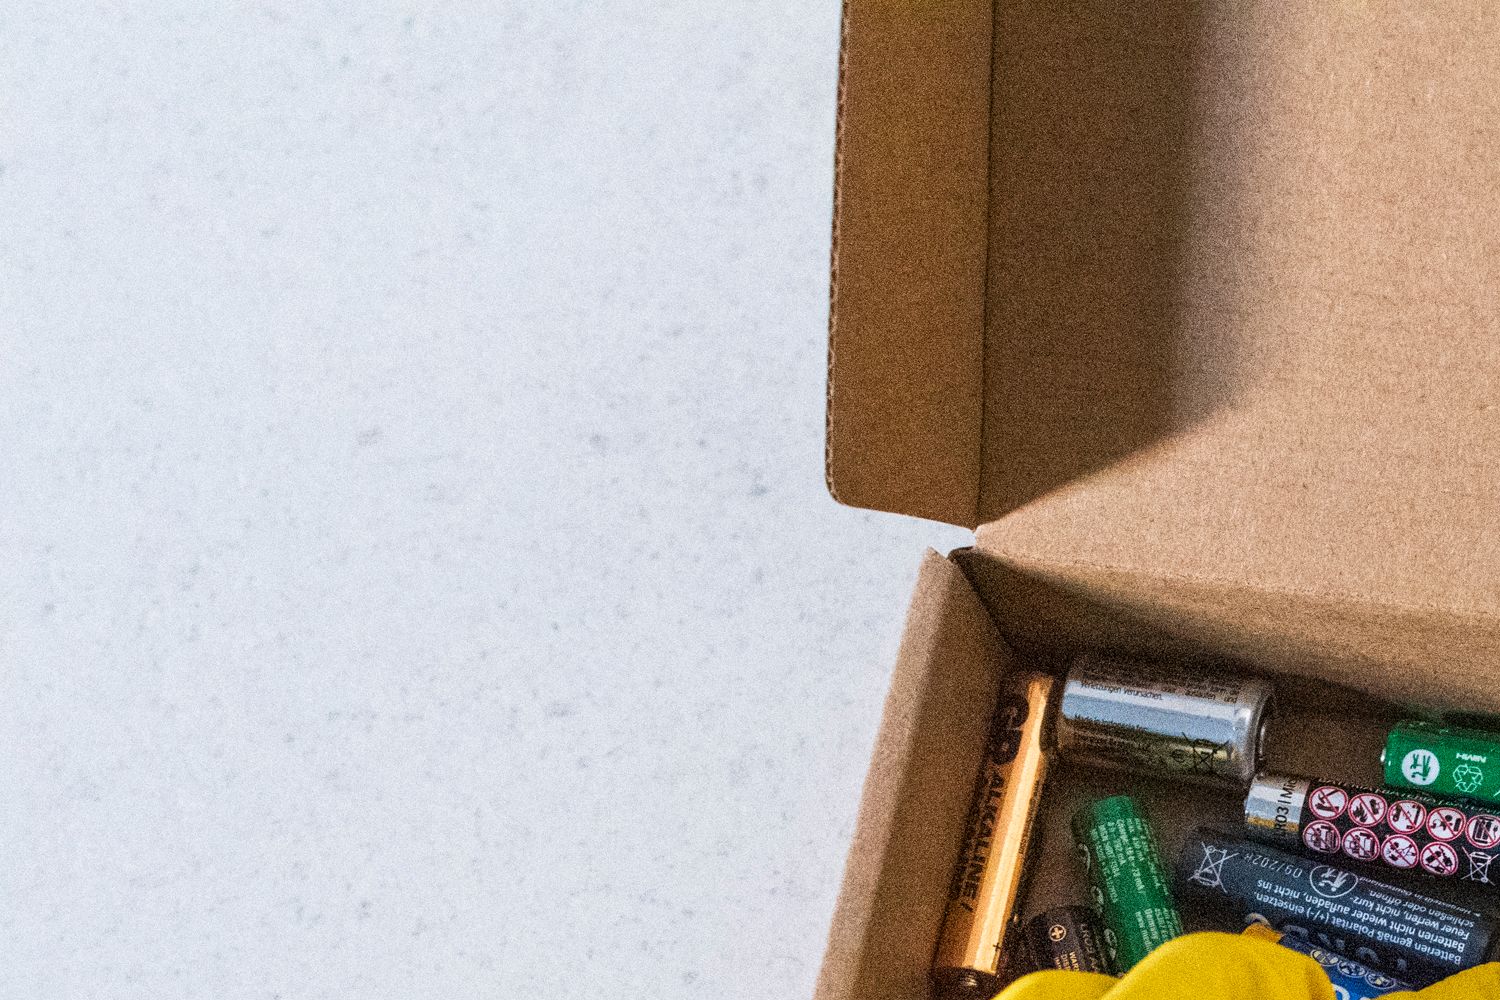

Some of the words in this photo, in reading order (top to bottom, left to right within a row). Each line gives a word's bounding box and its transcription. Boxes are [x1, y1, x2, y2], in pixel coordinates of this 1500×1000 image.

[961, 773, 1006, 900] ALKALINE
[1255, 877, 1273, 892] ins
[1272, 883, 1301, 901] nicht
[1251, 890, 1306, 915] einsetzen.
[1300, 890, 1352, 917] aufladen,
[1347, 893, 1375, 910] kurz-
[1374, 901, 1401, 918] nicht
[1401, 899, 1427, 914] oder
[1329, 915, 1375, 938] Polarität
[1350, 907, 1389, 929] wieder
[1387, 919, 1416, 937] nicht
[1400, 908, 1441, 930] werfen,
[1425, 906, 1475, 930] schließen
[1375, 928, 1413, 949] gemäß
[1415, 928, 1466, 953] Batterien
[1439, 922, 1470, 940] Feuer
[1411, 941, 1462, 965] Batterien
